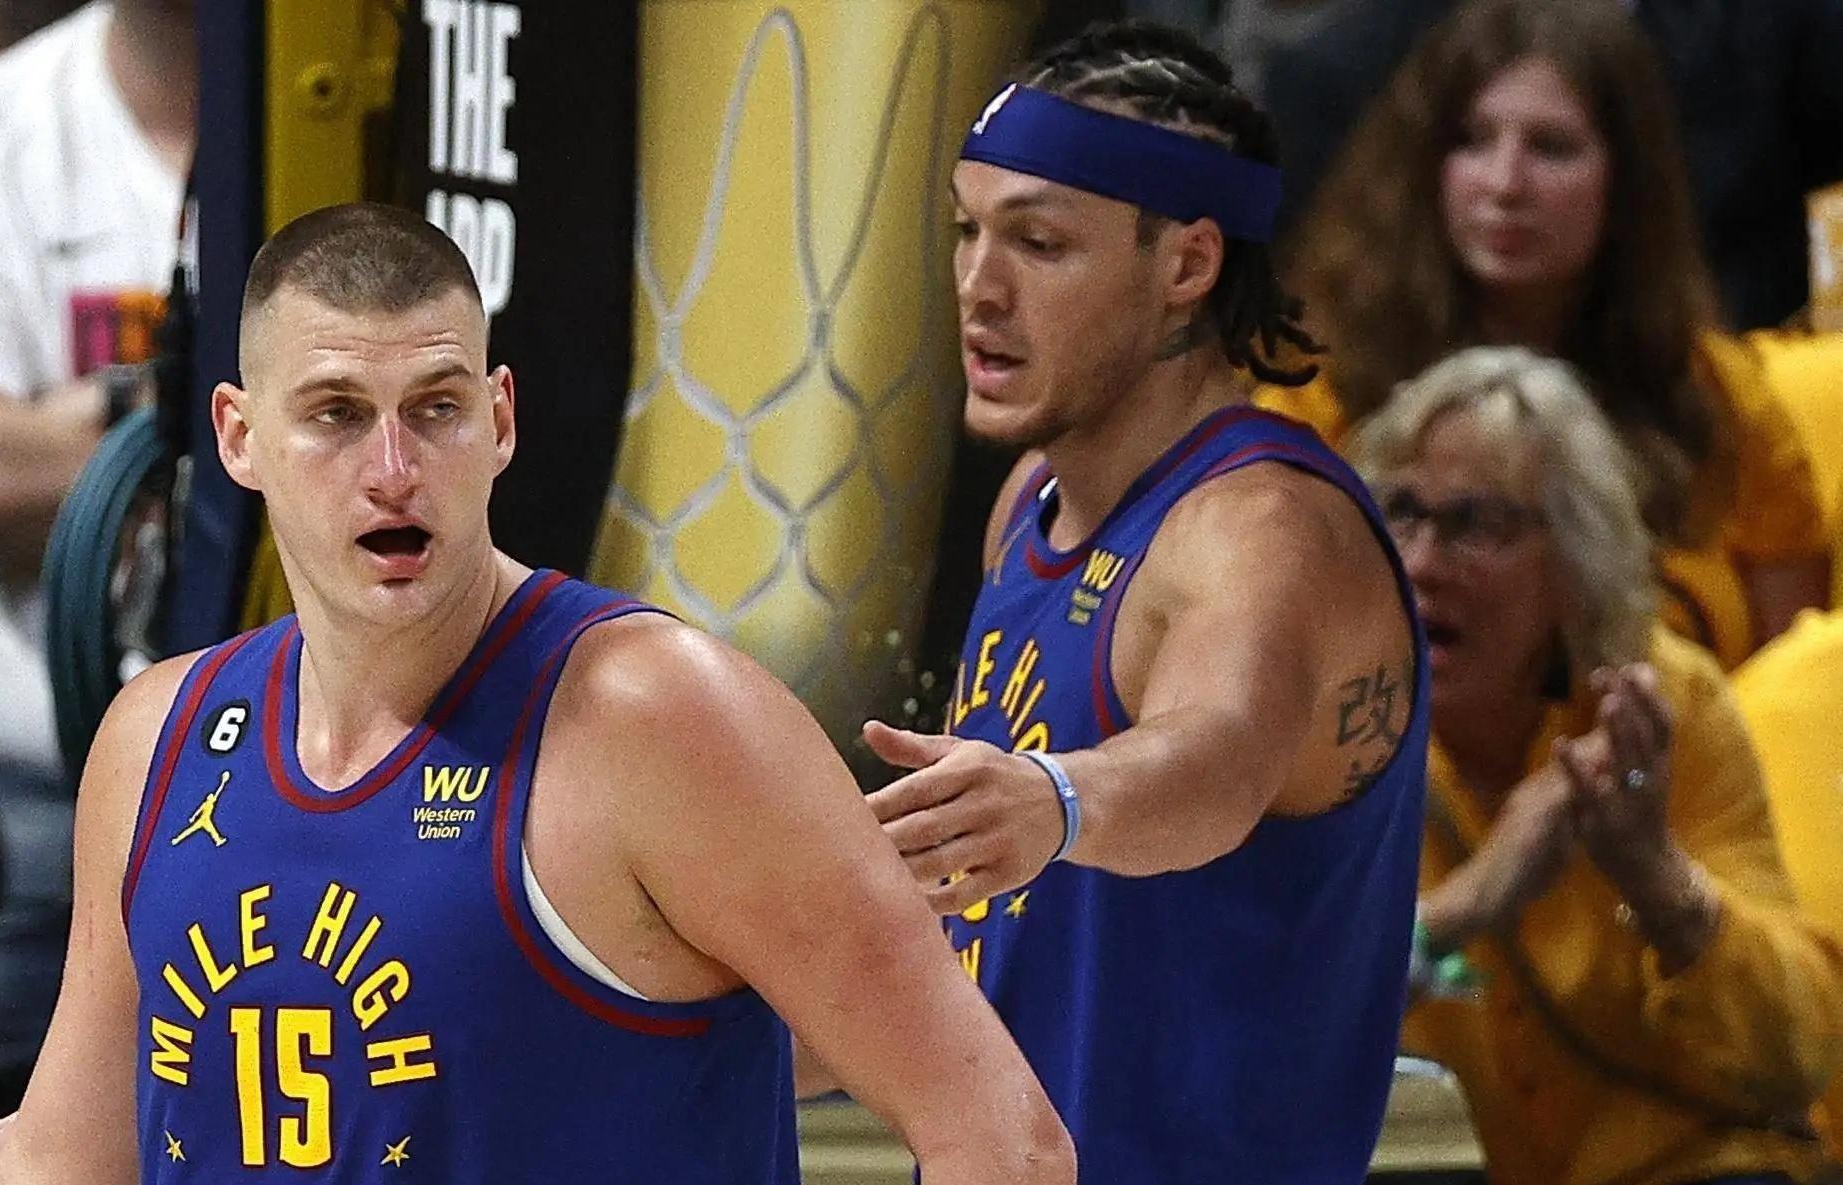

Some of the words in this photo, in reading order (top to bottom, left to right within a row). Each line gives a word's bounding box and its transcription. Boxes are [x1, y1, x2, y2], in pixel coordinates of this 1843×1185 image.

[420, 0, 522, 185] THE
[1081, 549, 1125, 591] WU
[209, 707, 247, 751] 6
[423, 766, 490, 802] WU
[413, 807, 476, 824] Western
[417, 822, 461, 839] Union
[150, 884, 276, 1087] MILE
[302, 882, 437, 1087] HIGH
[229, 1007, 333, 1168] 15
